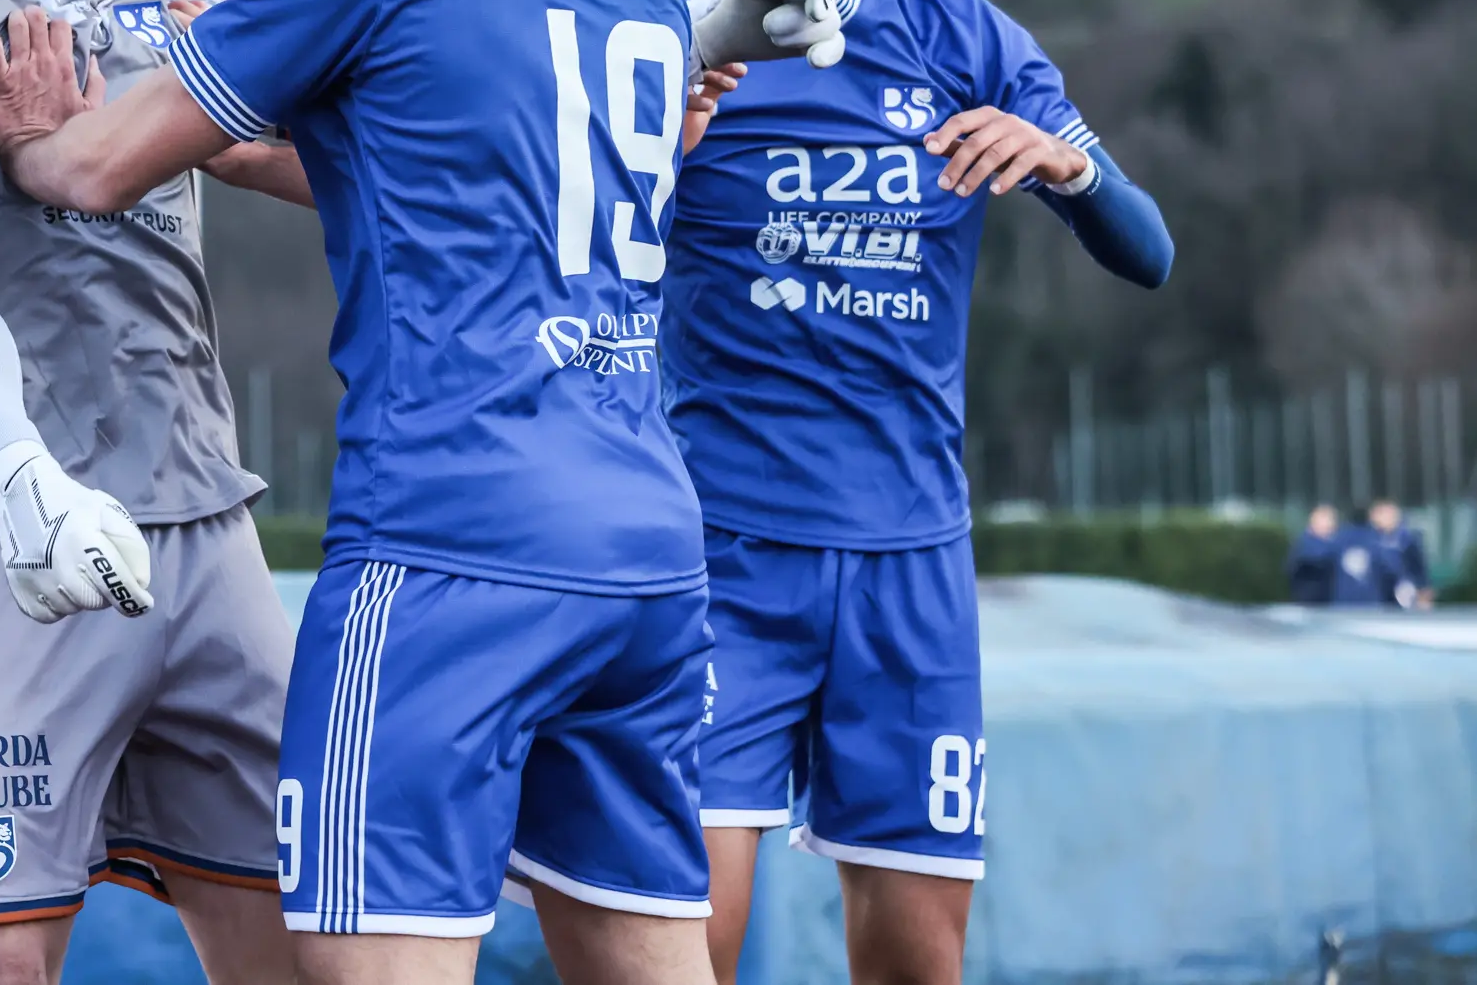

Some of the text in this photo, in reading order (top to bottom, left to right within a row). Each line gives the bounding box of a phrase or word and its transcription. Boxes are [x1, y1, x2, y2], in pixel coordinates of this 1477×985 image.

[546, 8, 684, 283] 19
[765, 145, 922, 204] a2a
[816, 211, 923, 225] COMPANY
[815, 281, 929, 321] Marsh
[84, 547, 149, 617] reusch
[276, 778, 303, 893] 9
